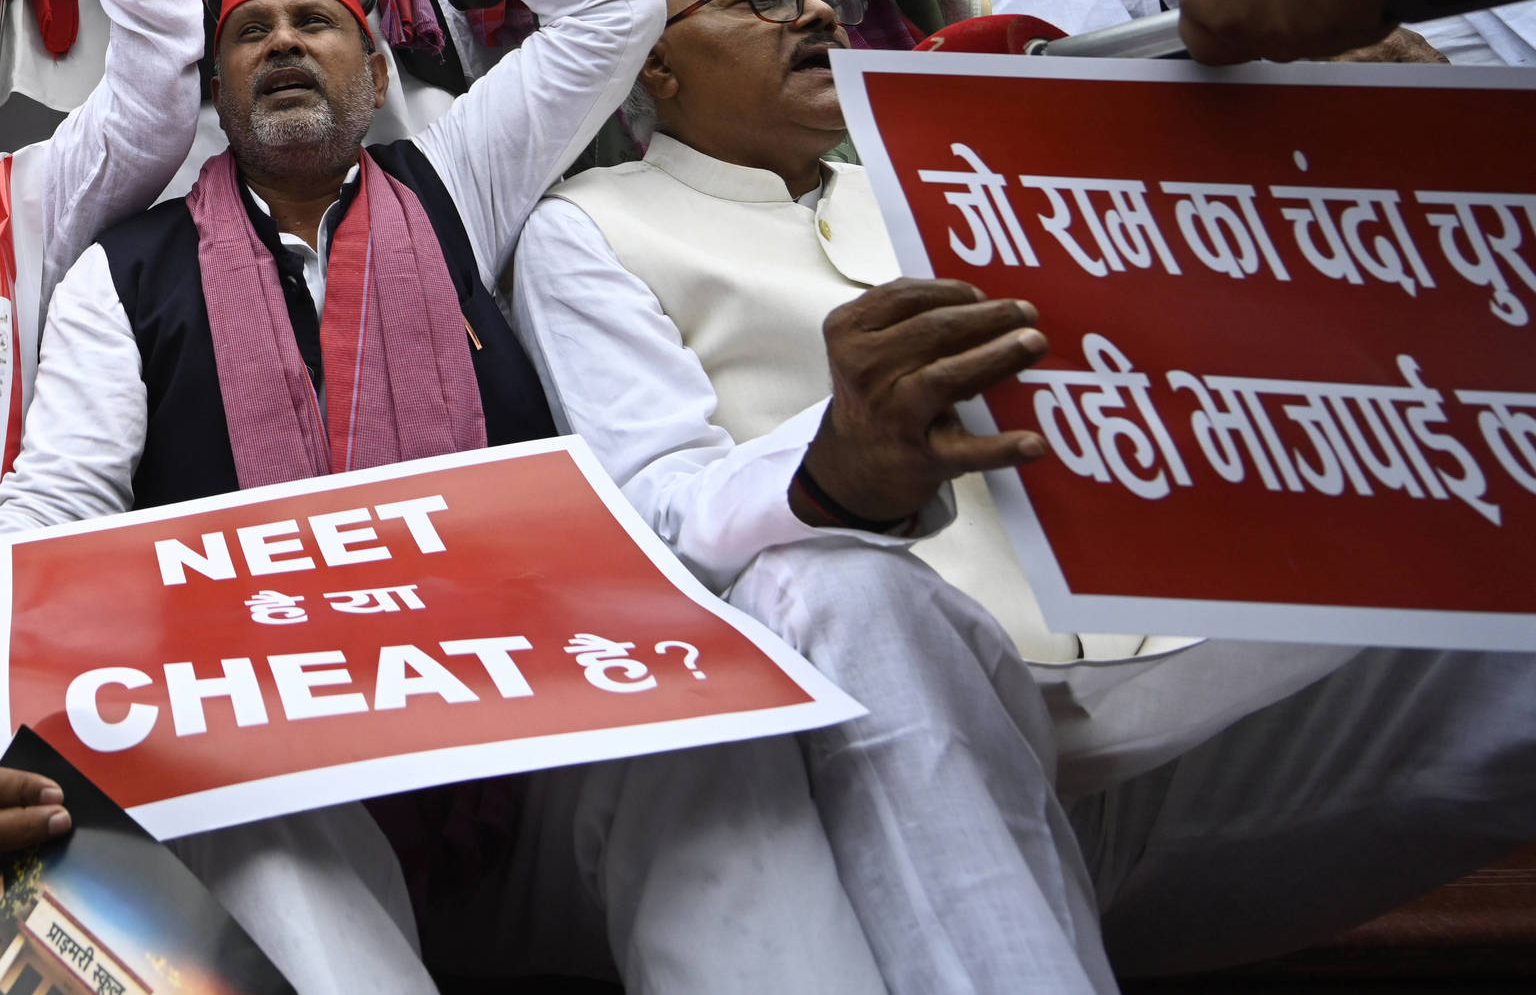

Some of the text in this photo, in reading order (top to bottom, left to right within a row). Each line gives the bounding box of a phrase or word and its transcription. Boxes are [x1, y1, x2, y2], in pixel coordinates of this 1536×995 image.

[918, 143, 1536, 327] जो राम का चंदा चुर
[1018, 334, 1194, 500] वही
[1169, 354, 1501, 526] भाजपाई
[154, 494, 449, 586] NEET
[244, 584, 426, 625] है या
[65, 634, 536, 753] CHEAT
[46, 921, 126, 995] प्राइमरी स्कूल
